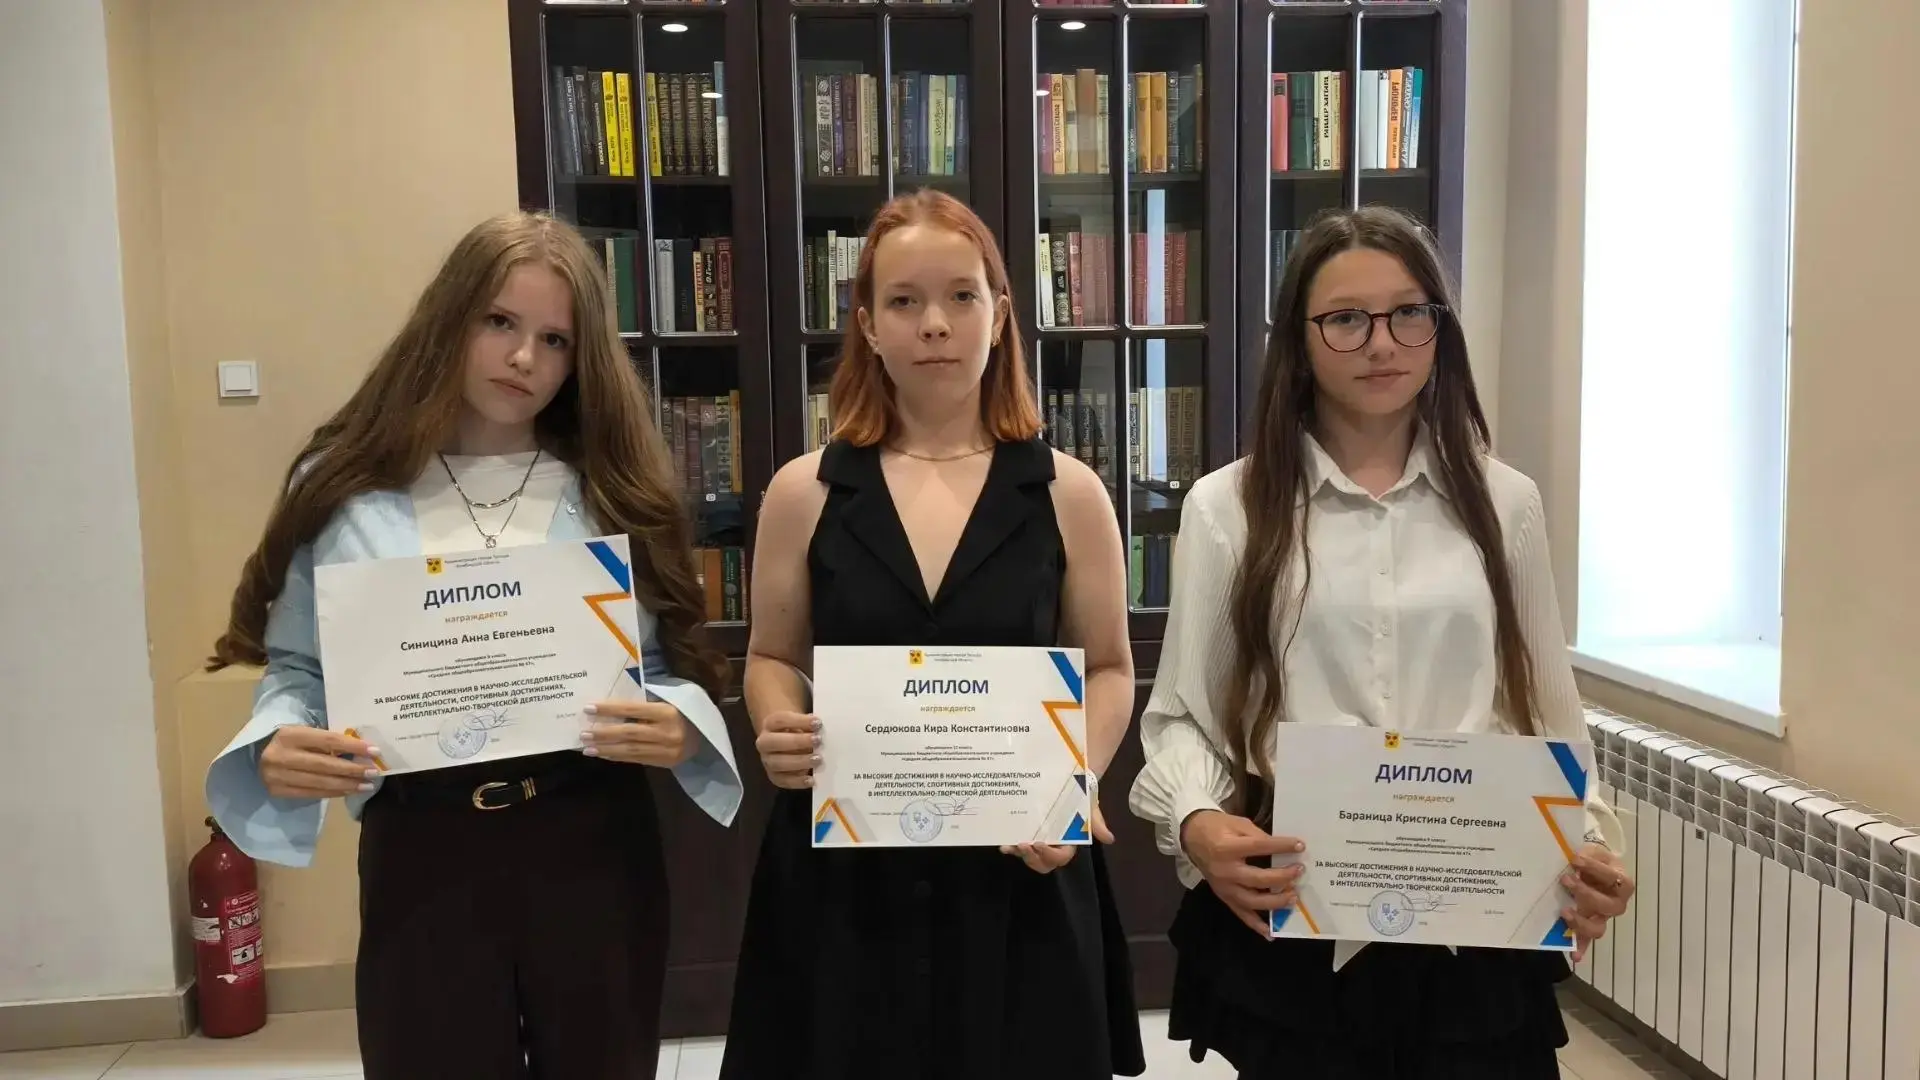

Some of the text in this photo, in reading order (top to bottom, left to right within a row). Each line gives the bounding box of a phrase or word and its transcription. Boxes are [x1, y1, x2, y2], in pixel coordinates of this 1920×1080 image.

[1391, 81, 1400, 121] АЭРОПОРТ
[423, 581, 521, 610] ДИПЛОМ
[444, 610, 508, 623] награждается
[400, 626, 555, 651] Синицина Анна Евгеньевна
[374, 697, 384, 705] ЗА
[384, 693, 420, 703] ВЫСОКИЕ
[421, 686, 473, 699] ДОСТИЖЕНИЯ
[480, 670, 588, 690] НАУЧНО-ИССЛЕДОВАТЕЛЬСКОЙ
[903, 679, 989, 697] ДИПЛОМ
[399, 683, 566, 712] ДЕЯТЕЛЬНОСТИ, СПОРТИВНЫХ ДОСТИЖЕНИЯХ,
[399, 697, 519, 719] ИНТЕЛЛЕКТУАЛЬНО-ТВОРЧЕСКОЙ
[519, 691, 574, 705] ДЕЯТЕЛЬНОСТИ
[865, 724, 1030, 735] Сердюкова Кира Константиновна
[894, 772, 939, 780] ДОСТИЖЕНИЯ
[945, 771, 1041, 779] НАУЧНО-ИССЛЕДОВАТЕЛЬСКОЙ
[1375, 764, 1472, 784] ДИПЛОМ
[873, 789, 978, 797] ИНТЕЛЛЕКТУАЛЬНО-ТВОРЧЕСКОЙ
[978, 789, 1028, 797] ДЕЯТЕЛЬНОСТИ
[874, 781, 926, 789] ДЕЯТЕЛЬНОСТИ,
[1393, 794, 1455, 803] награждается
[1339, 810, 1507, 828] Бараница Кристина Сергеевна
[1324, 861, 1358, 869] ВЫСОКИЕ
[1359, 863, 1408, 871] ДОСТИЖЕНИЯ
[1415, 866, 1522, 877] НАУЧНО-ИССЛЕДОВАТЕЛЬСКОЙ
[1329, 879, 1335, 887] В
[1451, 886, 1505, 895] ДЕЯТЕЛЬНОСТИ
[1337, 871, 1498, 886] ДЕЯТЕЛЬНОСТИ, СПОРТИВНЫХ ДОСТИЖЕНИЯХ,
